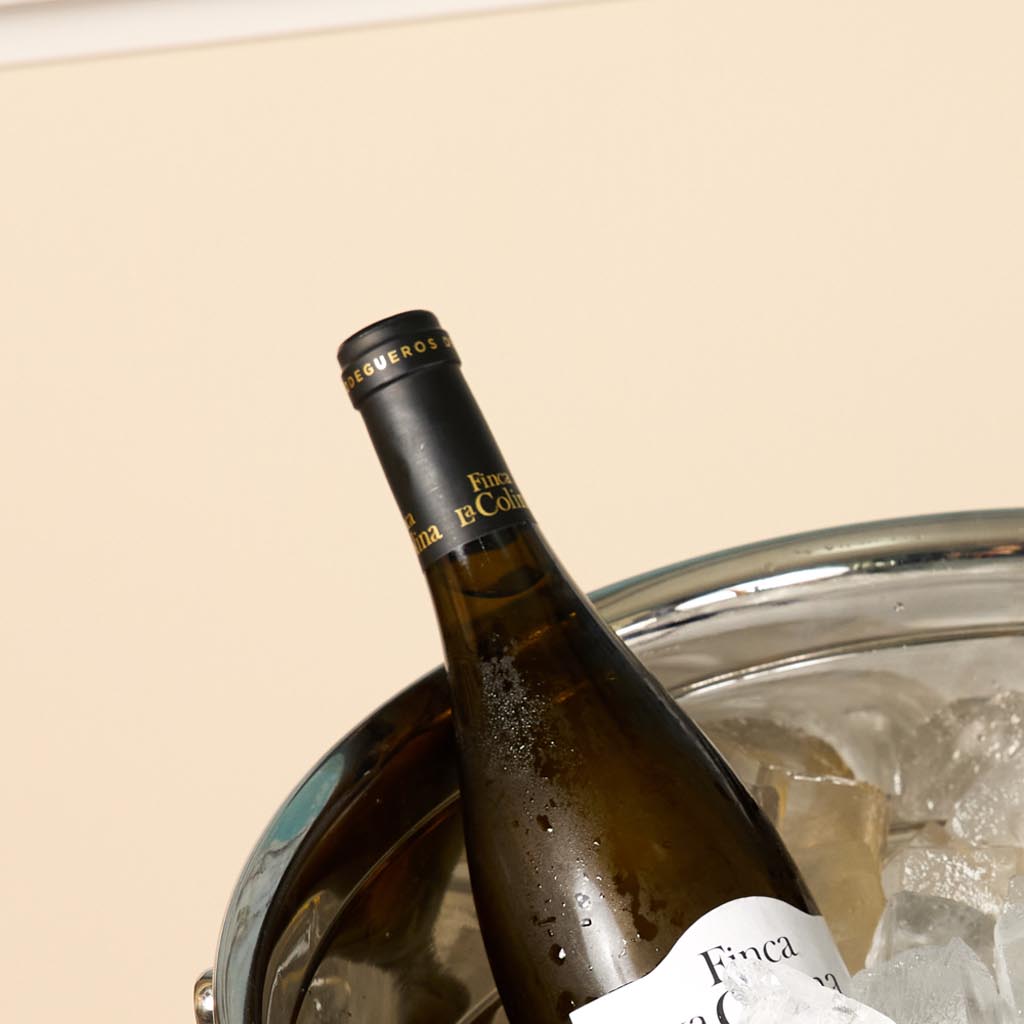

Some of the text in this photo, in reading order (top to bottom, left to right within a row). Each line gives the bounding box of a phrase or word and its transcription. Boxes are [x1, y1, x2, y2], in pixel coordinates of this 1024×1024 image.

[345, 338, 438, 391] DEGUEROS
[467, 471, 511, 492] Finca
[454, 504, 477, 528] La
